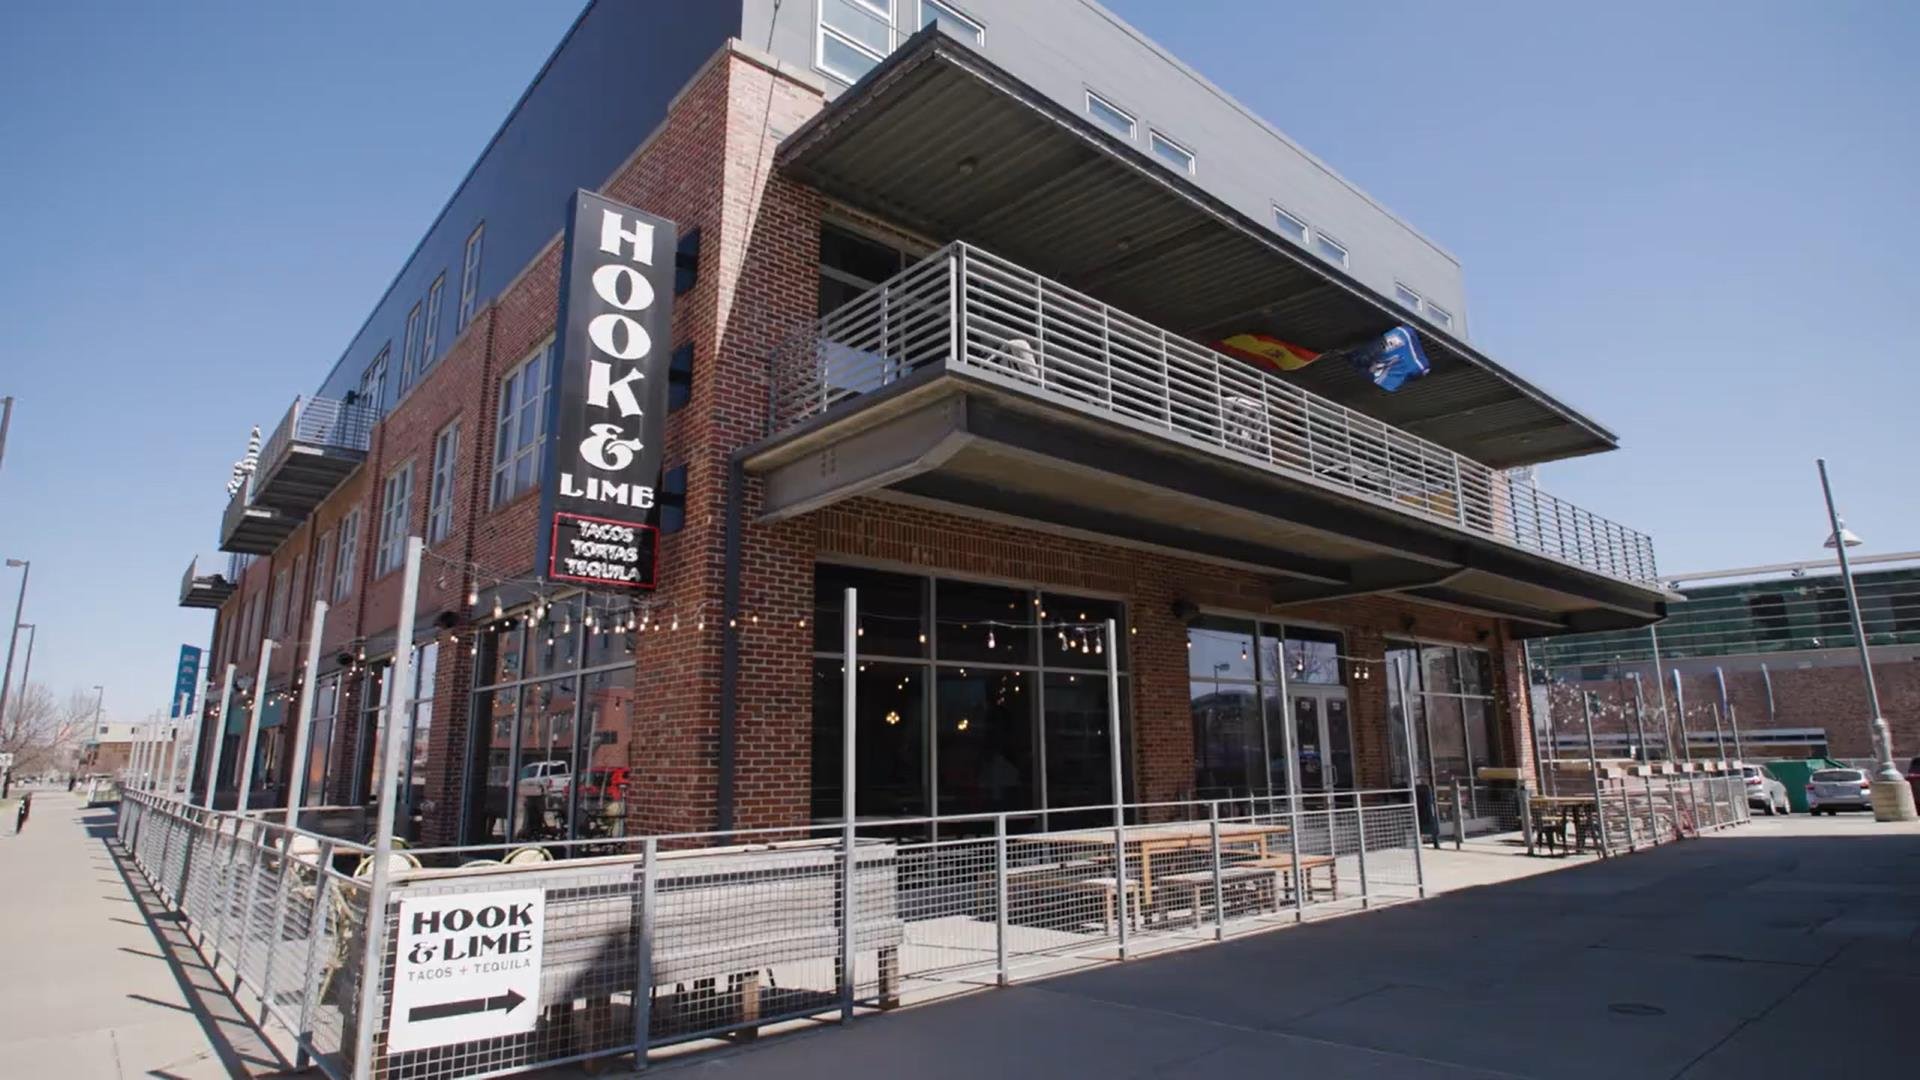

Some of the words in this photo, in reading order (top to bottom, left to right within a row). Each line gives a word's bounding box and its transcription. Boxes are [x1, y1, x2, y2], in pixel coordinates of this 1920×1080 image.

[587, 209, 655, 418] HOOK
[579, 423, 644, 471] &
[559, 473, 655, 509] LIME
[577, 520, 634, 543] TACOS
[571, 539, 638, 562] TORTAS
[564, 558, 641, 582] TEQUILA
[412, 902, 533, 935] HOOK
[408, 941, 437, 965] &
[443, 930, 532, 961] LIME
[408, 968, 453, 982] TACOS
[475, 958, 531, 974] TEQUILA
